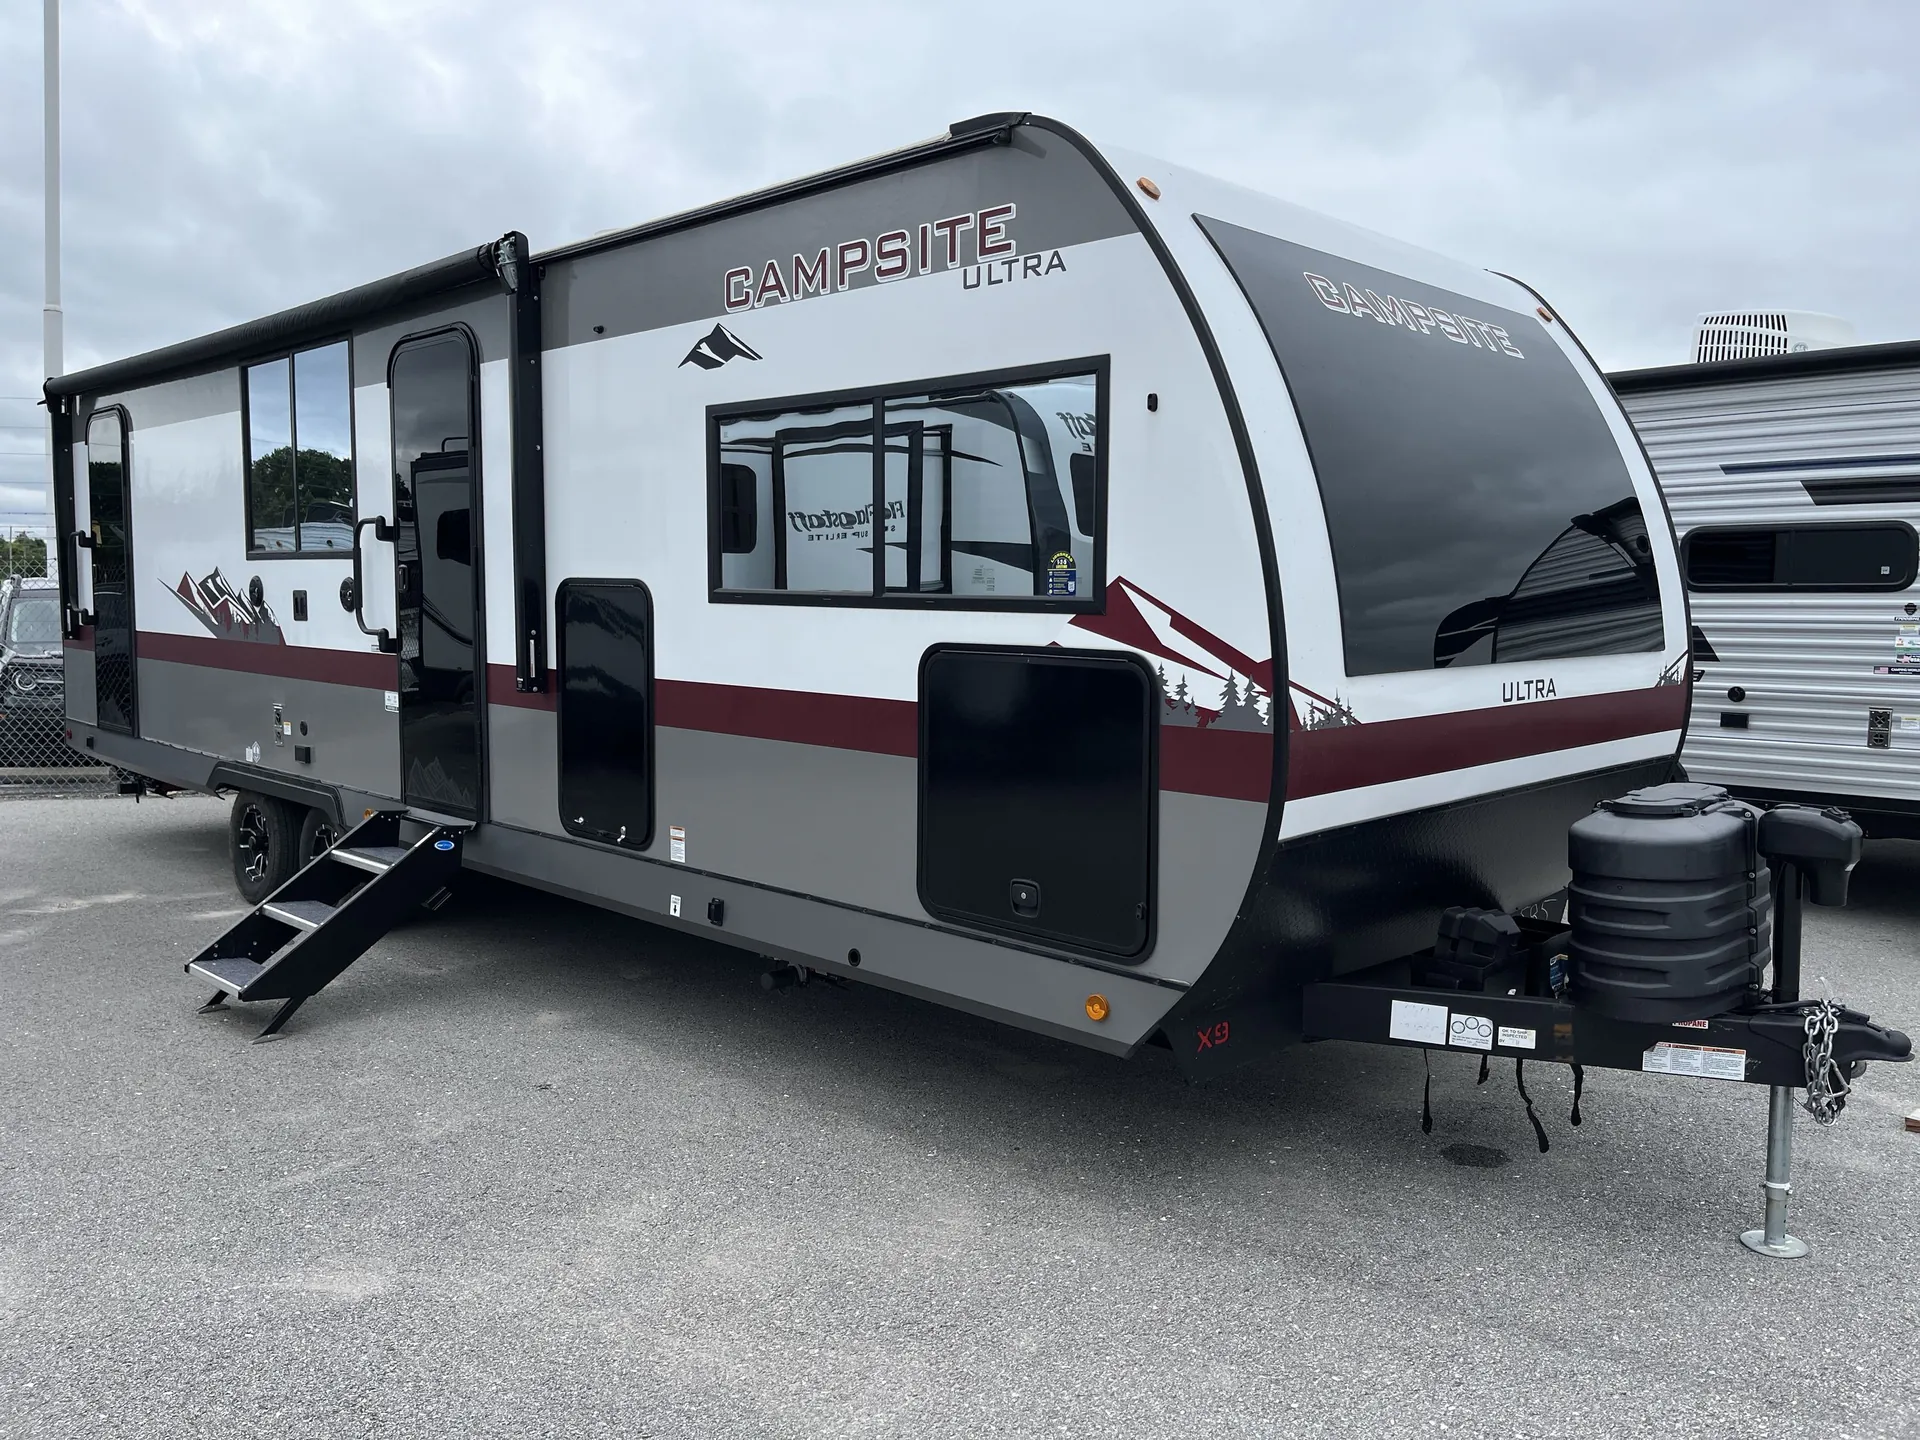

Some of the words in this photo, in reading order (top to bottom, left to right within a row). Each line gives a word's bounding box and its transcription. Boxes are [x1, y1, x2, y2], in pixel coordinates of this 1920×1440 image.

[724, 202, 1016, 314] CAMPSITE
[963, 250, 1067, 290] ULTRA
[1303, 271, 1525, 360] CAMPSITE
[1502, 678, 1557, 703] ULTRA
